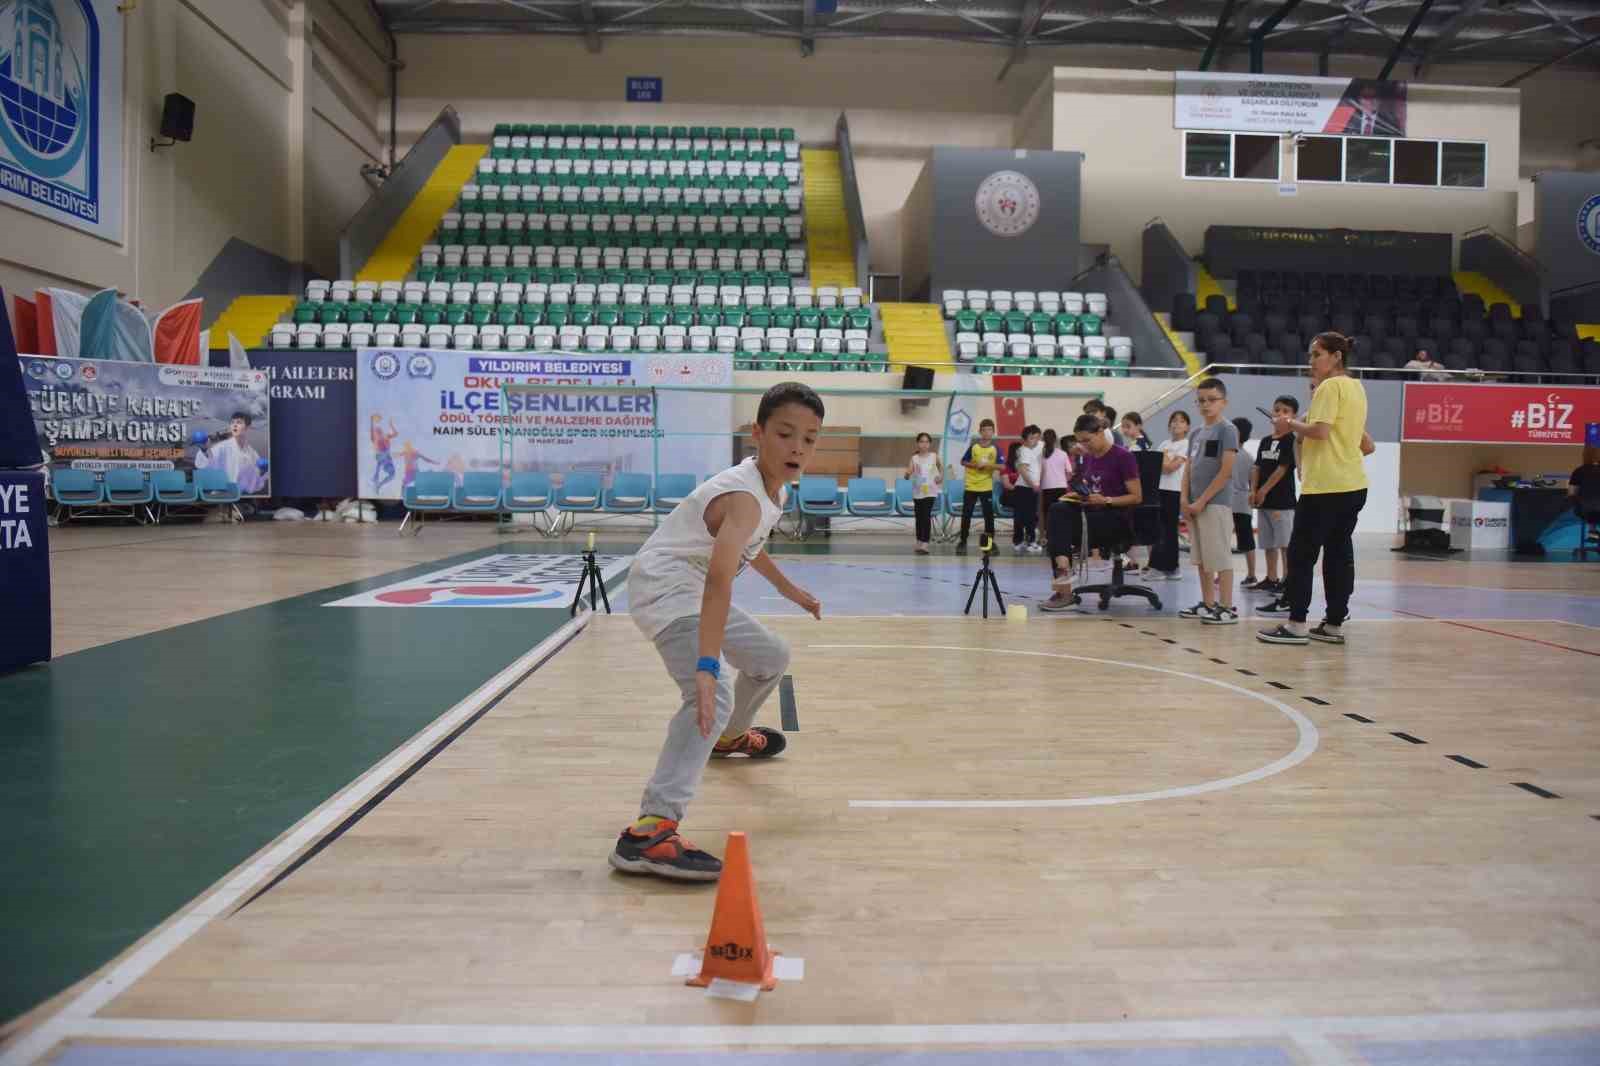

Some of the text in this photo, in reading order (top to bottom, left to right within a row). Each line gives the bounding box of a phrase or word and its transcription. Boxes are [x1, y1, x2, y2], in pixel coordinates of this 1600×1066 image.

[31, 180, 97, 220] BELEDİYESİ
[479, 361, 623, 374] YILDIRIM BELEDİYESİ
[440, 390, 500, 413] İLÇE
[46, 416, 187, 445] ŞAMPİYONASI
[433, 427, 464, 436] NAİM
